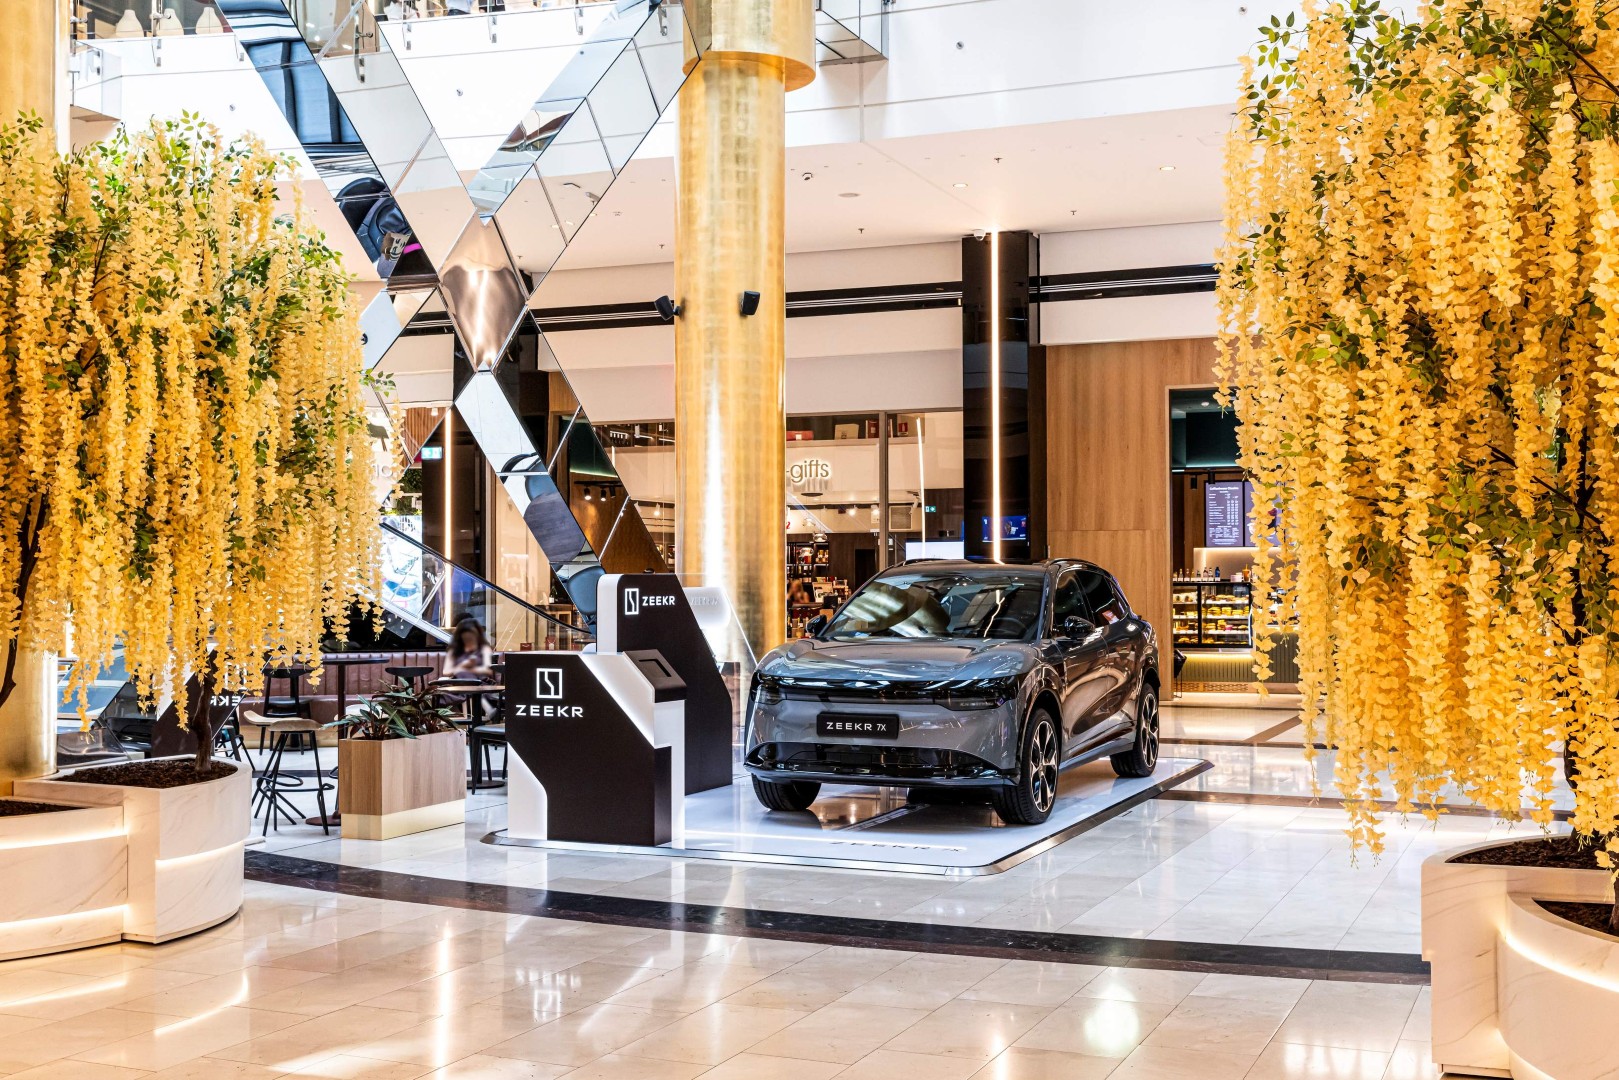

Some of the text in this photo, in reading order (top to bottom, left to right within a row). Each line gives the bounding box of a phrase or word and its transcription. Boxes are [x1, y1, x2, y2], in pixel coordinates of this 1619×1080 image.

[642, 595, 676, 607] ZEEKR
[515, 704, 584, 718] ZEEKR
[826, 721, 887, 732] ZEEKR 7X
